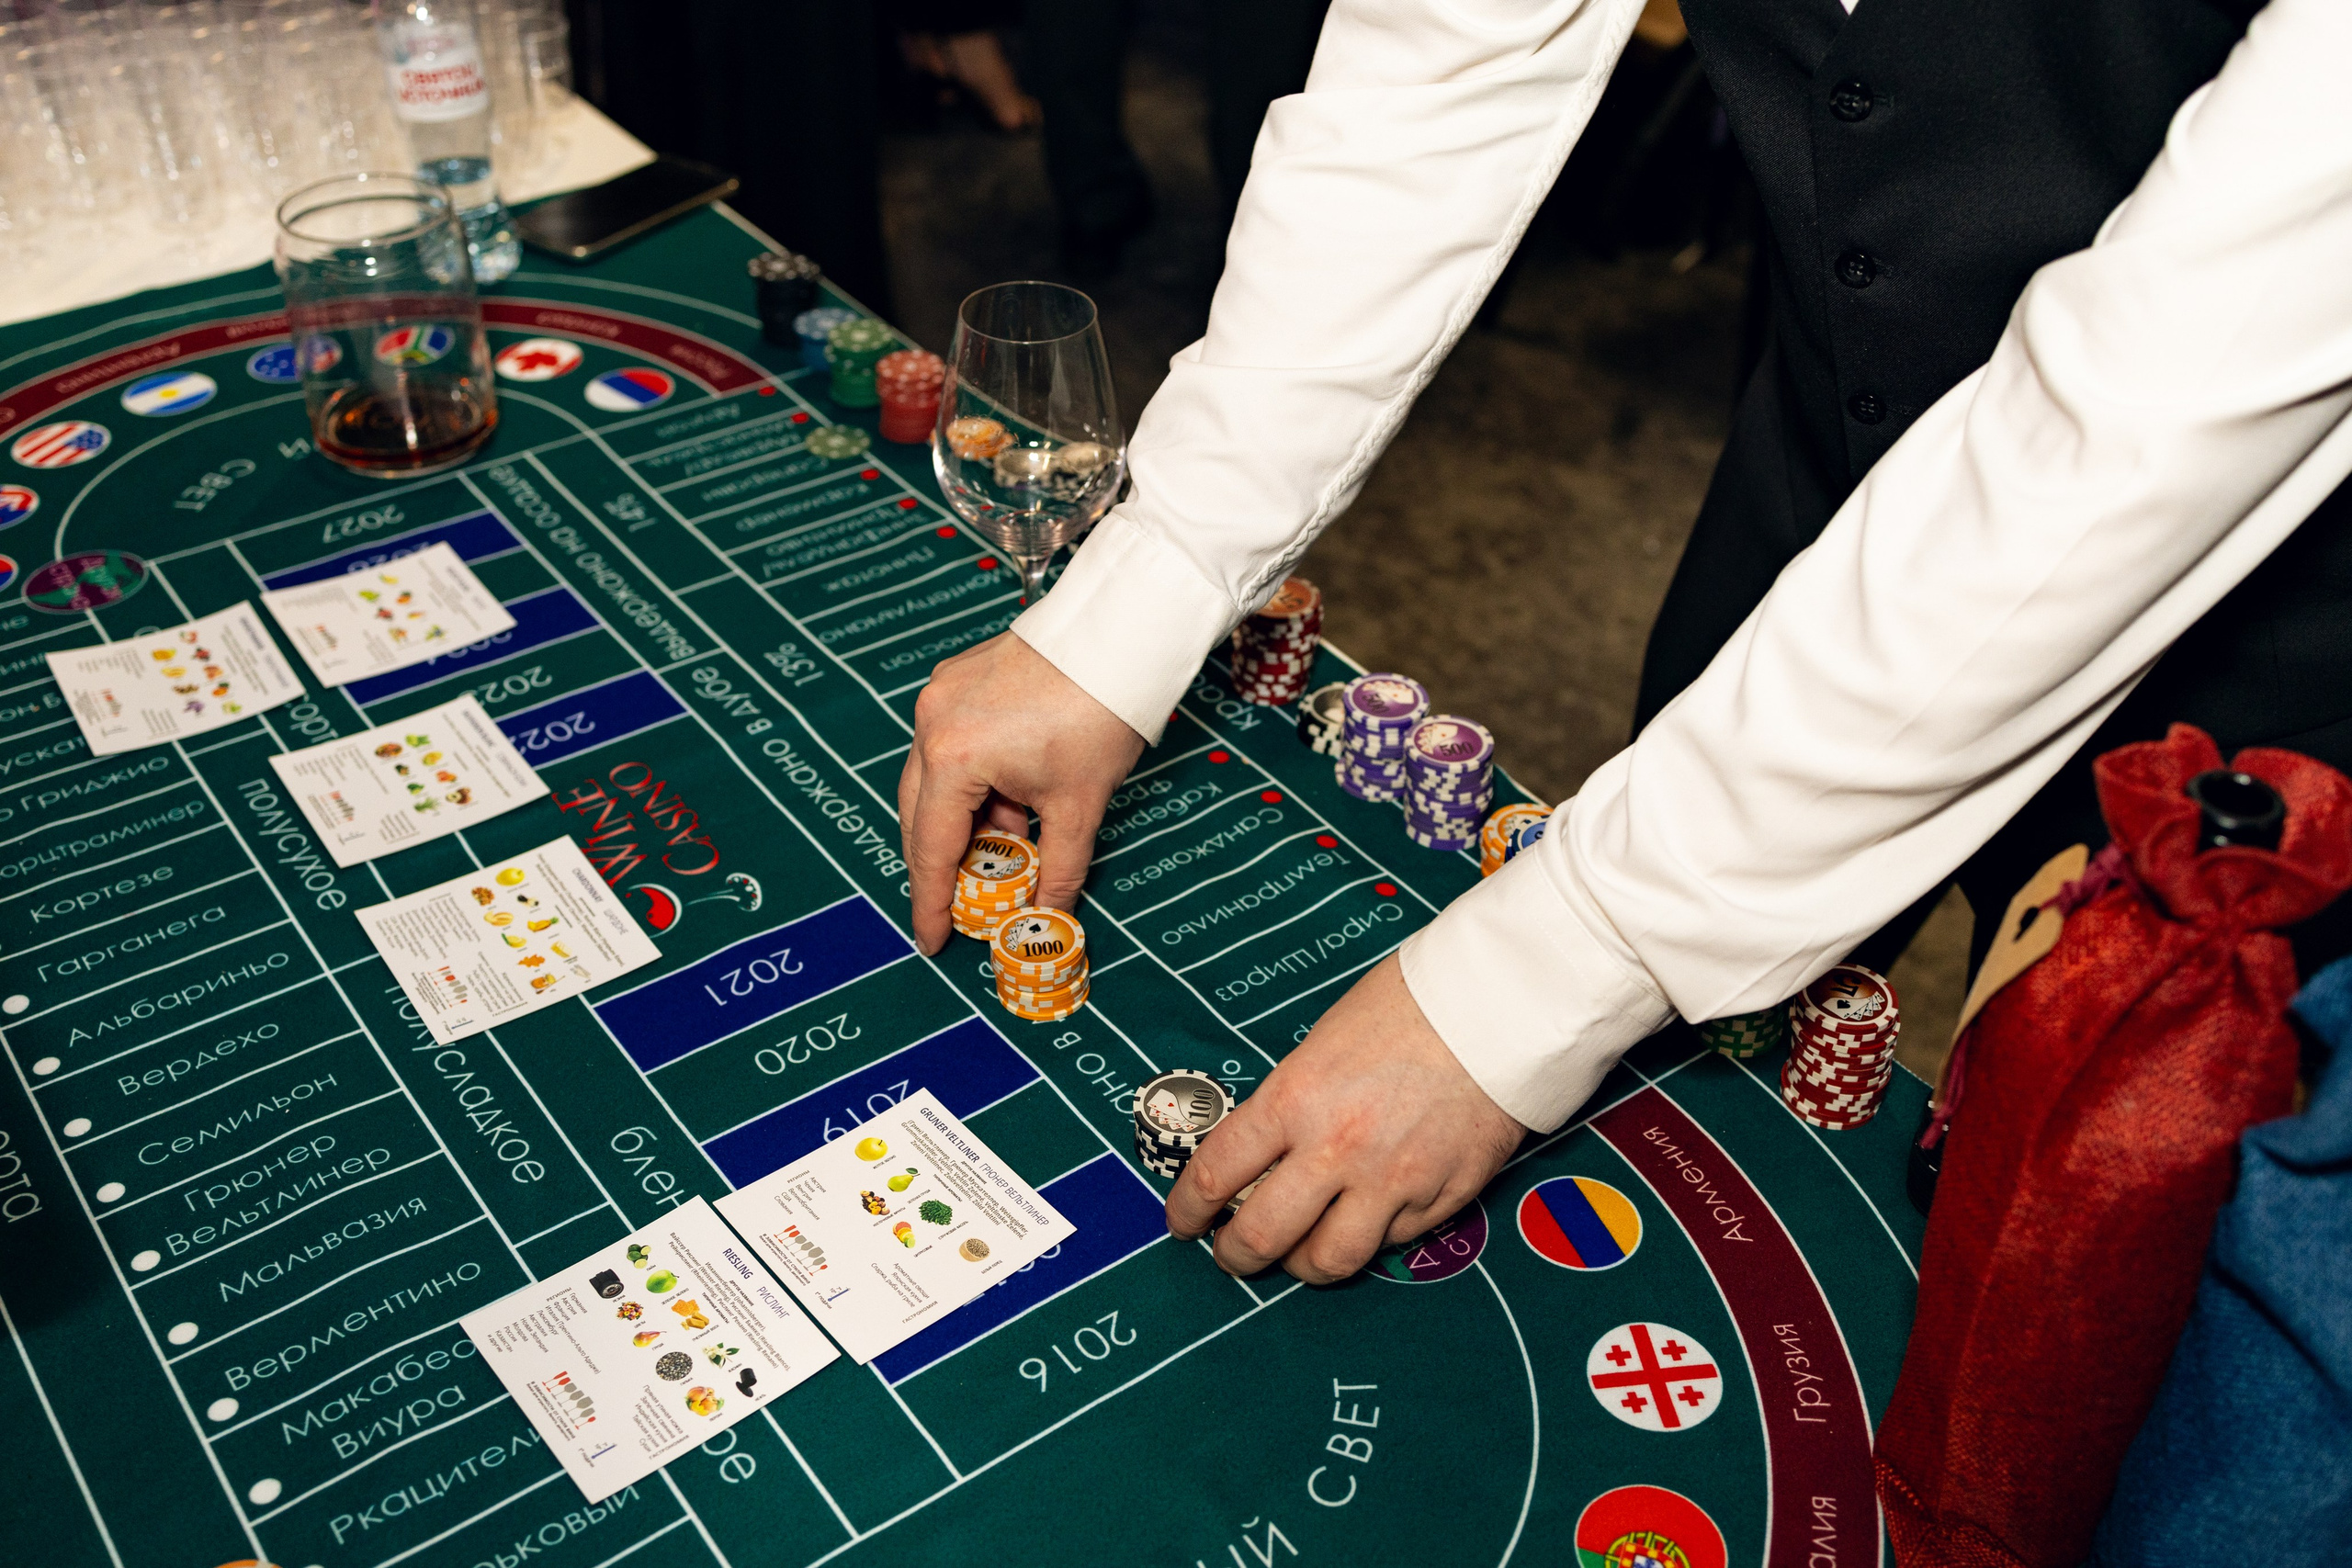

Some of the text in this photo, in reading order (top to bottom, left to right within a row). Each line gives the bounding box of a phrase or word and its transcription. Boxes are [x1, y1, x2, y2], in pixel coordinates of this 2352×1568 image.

[322, 503, 406, 544] 2027
[763, 642, 824, 687] 13%
[509, 710, 596, 755] 202
[1439, 740, 1474, 758] 500
[19, 755, 170, 813] Гриджио
[691, 665, 908, 878] выдержано в дубе
[551, 777, 649, 889] WINE
[608, 761, 720, 876] CASINO
[1098, 780, 1224, 841] Каберне
[238, 777, 348, 911] полусухое
[974, 838, 1016, 859] 1000
[1113, 807, 1284, 893] Санджовезе
[29, 865, 175, 924] Кортезе
[1160, 850, 1351, 946] Темпранильо
[37, 906, 227, 983] Гарганега
[1022, 939, 1065, 958] 1000
[68, 952, 290, 1048] Альбариньо
[704, 948, 804, 1007] 2021
[117, 1022, 280, 1096] Вердехо
[753, 1011, 862, 1076] 2020
[137, 1073, 338, 1166] Семильон
[1187, 1088, 1215, 1121] 100
[184, 1134, 336, 1212] Грюнер
[779, 1190, 793, 1202] США
[808, 1176, 828, 1193] Австрия
[918, 1106, 1050, 1227] GRUNER VELTLINER ГРЮНЕР ВЕЛЬТЛИНЕР
[1641, 1125, 1755, 1244] Армения
[164, 1147, 391, 1257] Вельтлинер
[773, 1194, 795, 1215] Словакия
[786, 1187, 821, 1222] Великобритания
[220, 1197, 428, 1303] Мальвазия
[545, 1286, 572, 1303] РЕГИОНЫ
[551, 1300, 571, 1322] Франция
[560, 1296, 578, 1315] Австрия
[568, 1292, 589, 1314] Германия
[721, 1247, 754, 1280] RIESLING
[754, 1285, 790, 1320] РИСЛИНГ
[225, 1261, 481, 1392] Верментино
[493, 1329, 514, 1353] Казахстан
[502, 1325, 518, 1343] Россия
[510, 1321, 530, 1343] Молдова
[518, 1316, 550, 1354] Новая Зеландия
[526, 1313, 548, 1337] Австралия
[534, 1308, 560, 1337] Люксембург
[1018, 1310, 1137, 1393] 2016
[281, 1338, 477, 1445] Макабео
[1771, 1322, 1833, 1424] Грузия
[331, 1385, 466, 1460] Виура
[1306, 1377, 1380, 1508] СВЕТ
